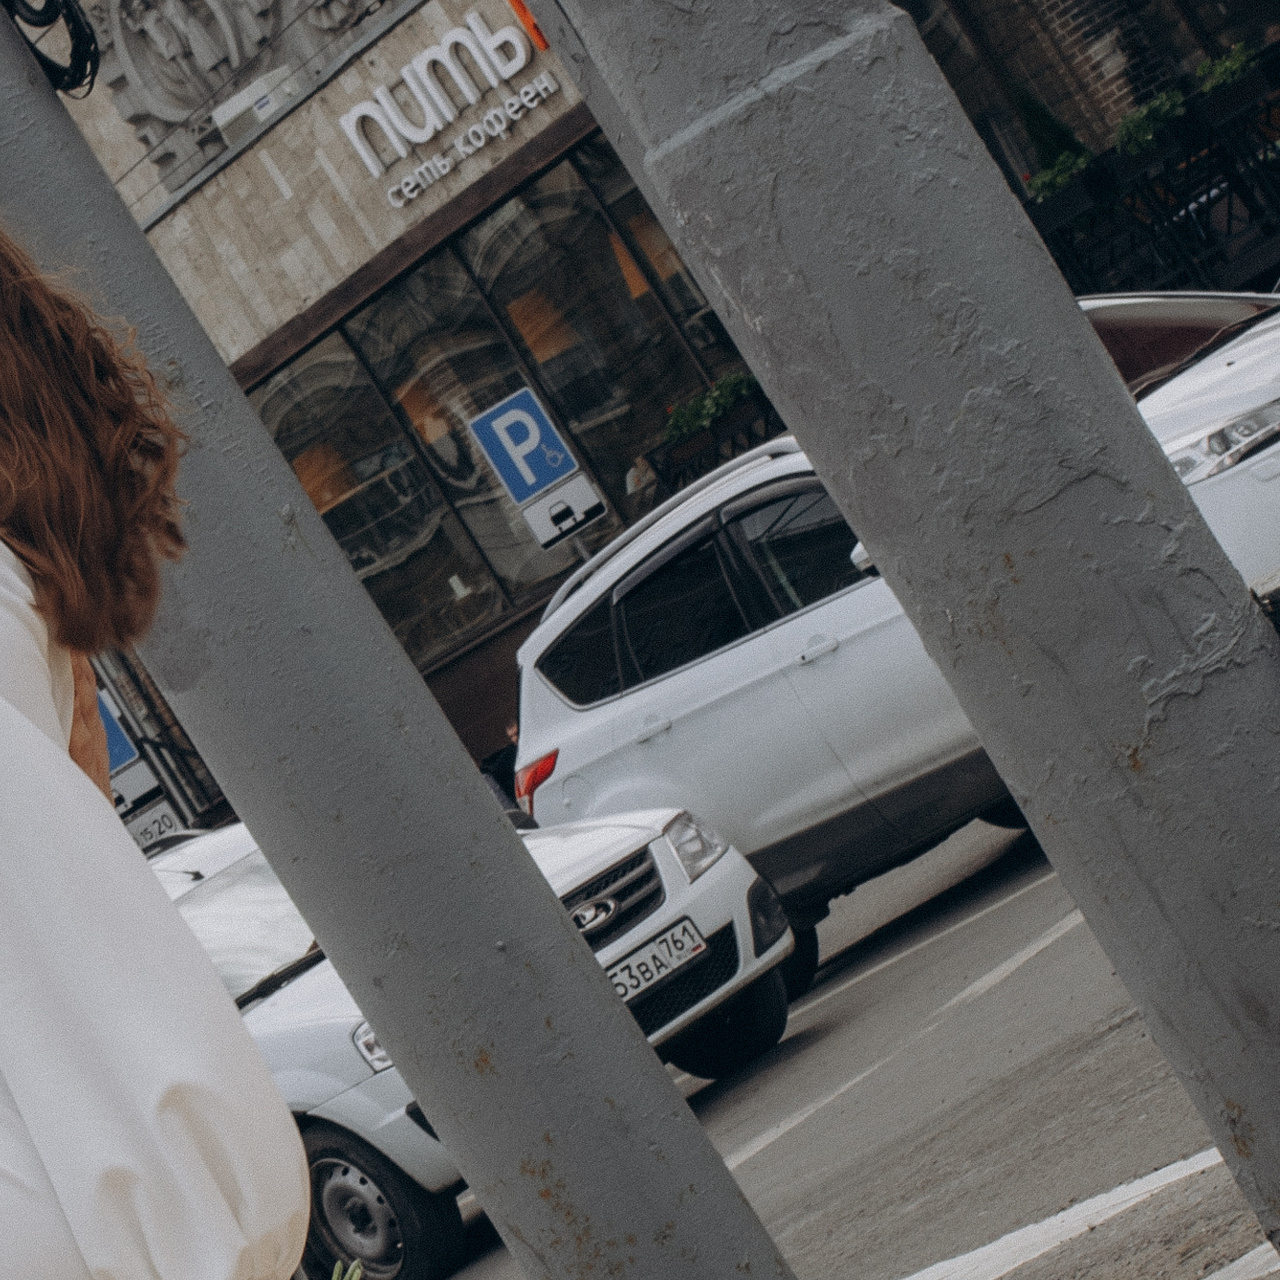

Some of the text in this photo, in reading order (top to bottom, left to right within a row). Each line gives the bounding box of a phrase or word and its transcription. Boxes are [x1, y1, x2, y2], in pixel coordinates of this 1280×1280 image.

[387, 71, 559, 209] сеть кофеен
[491, 408, 540, 486] P
[152, 813, 174, 835] 20
